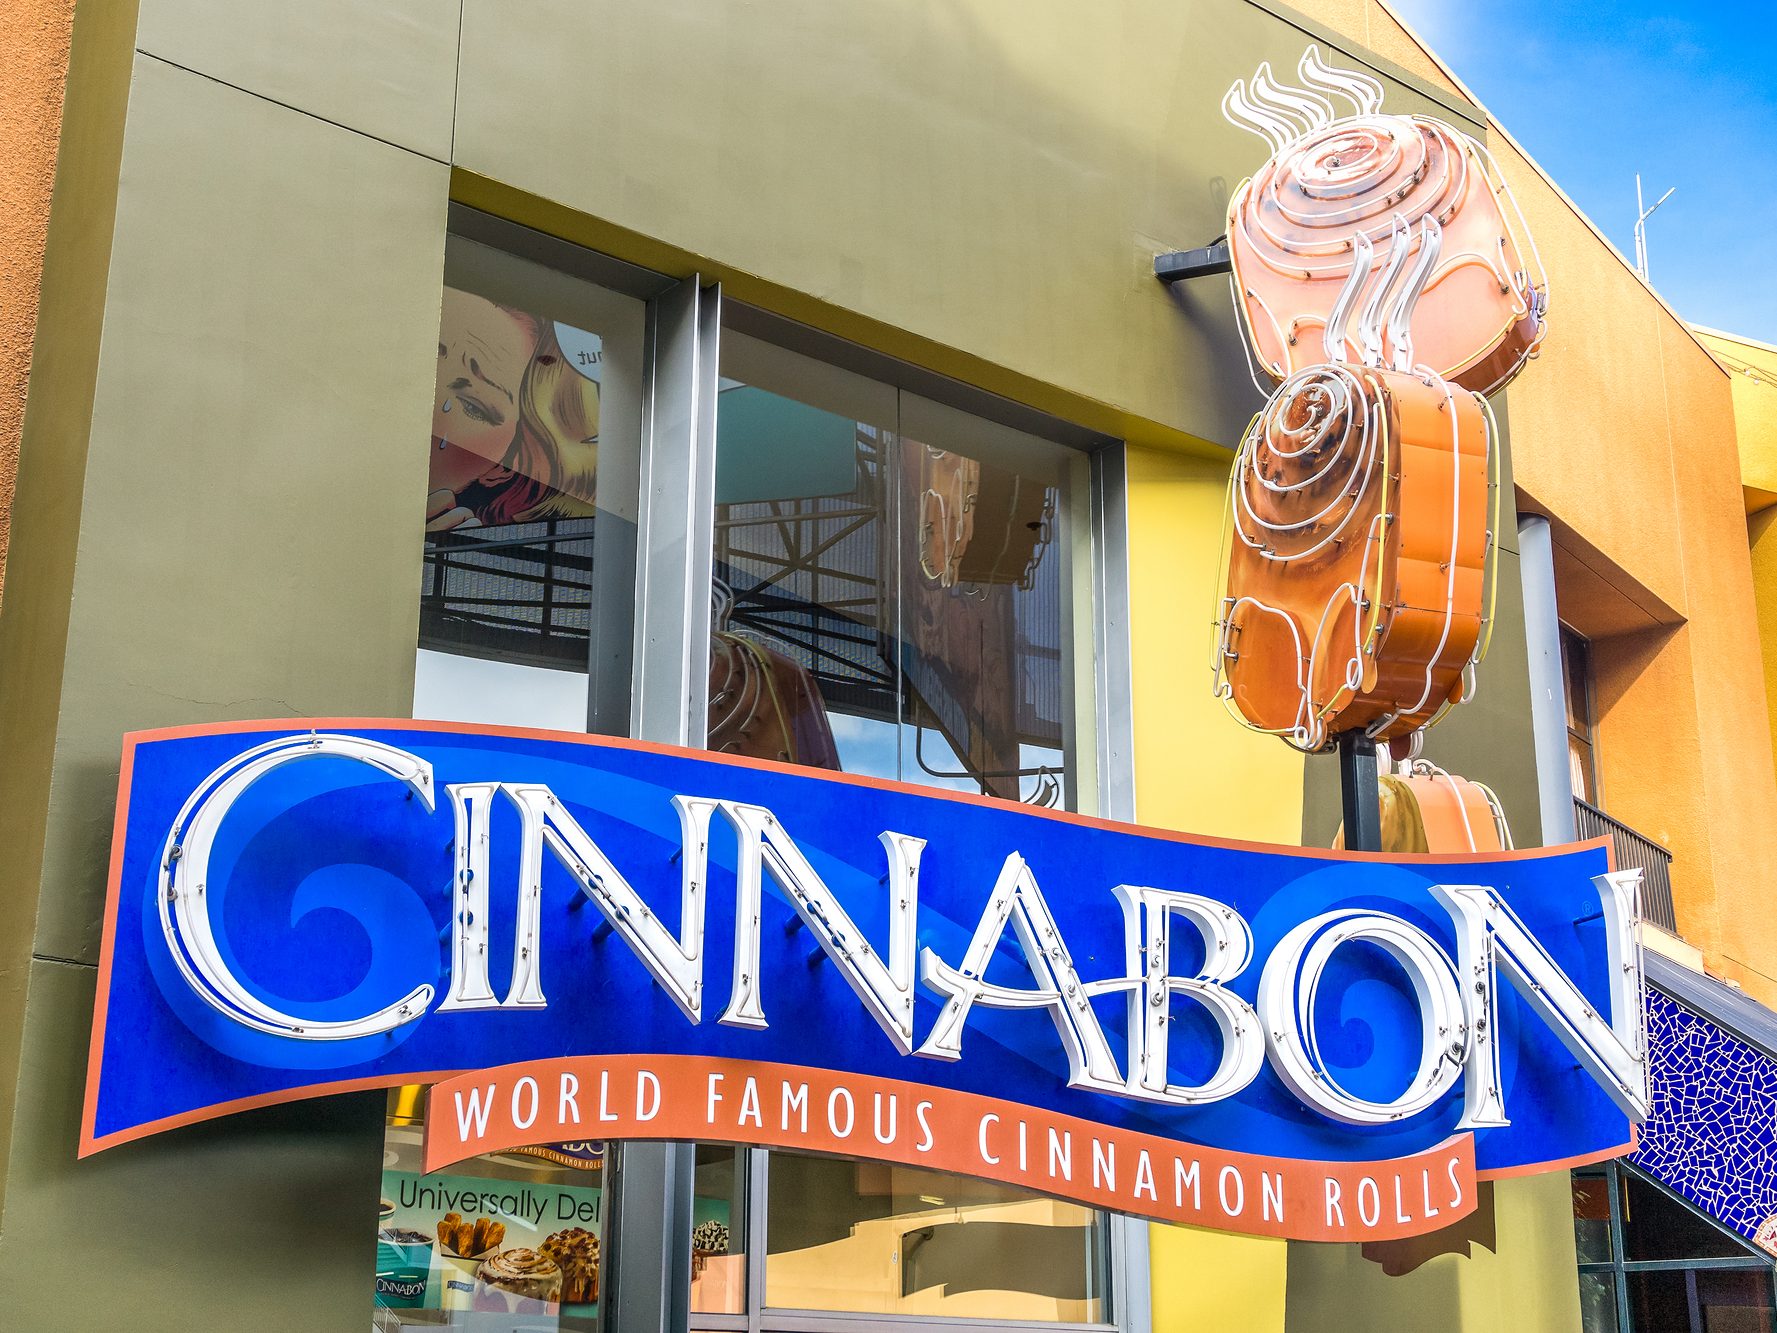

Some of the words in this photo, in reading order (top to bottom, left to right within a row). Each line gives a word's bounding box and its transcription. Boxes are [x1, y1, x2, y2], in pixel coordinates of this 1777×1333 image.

[157, 732, 1651, 1130] CINNABON
[454, 1070, 661, 1142] WORLD
[707, 1073, 935, 1152] FAMOUS
[978, 1113, 1284, 1223] CINNAMON
[1325, 1158, 1463, 1227] ROLLS
[548, 1151, 582, 1168] CINNAMON
[400, 1179, 548, 1225] Universally
[376, 1278, 426, 1296] CINNABON
